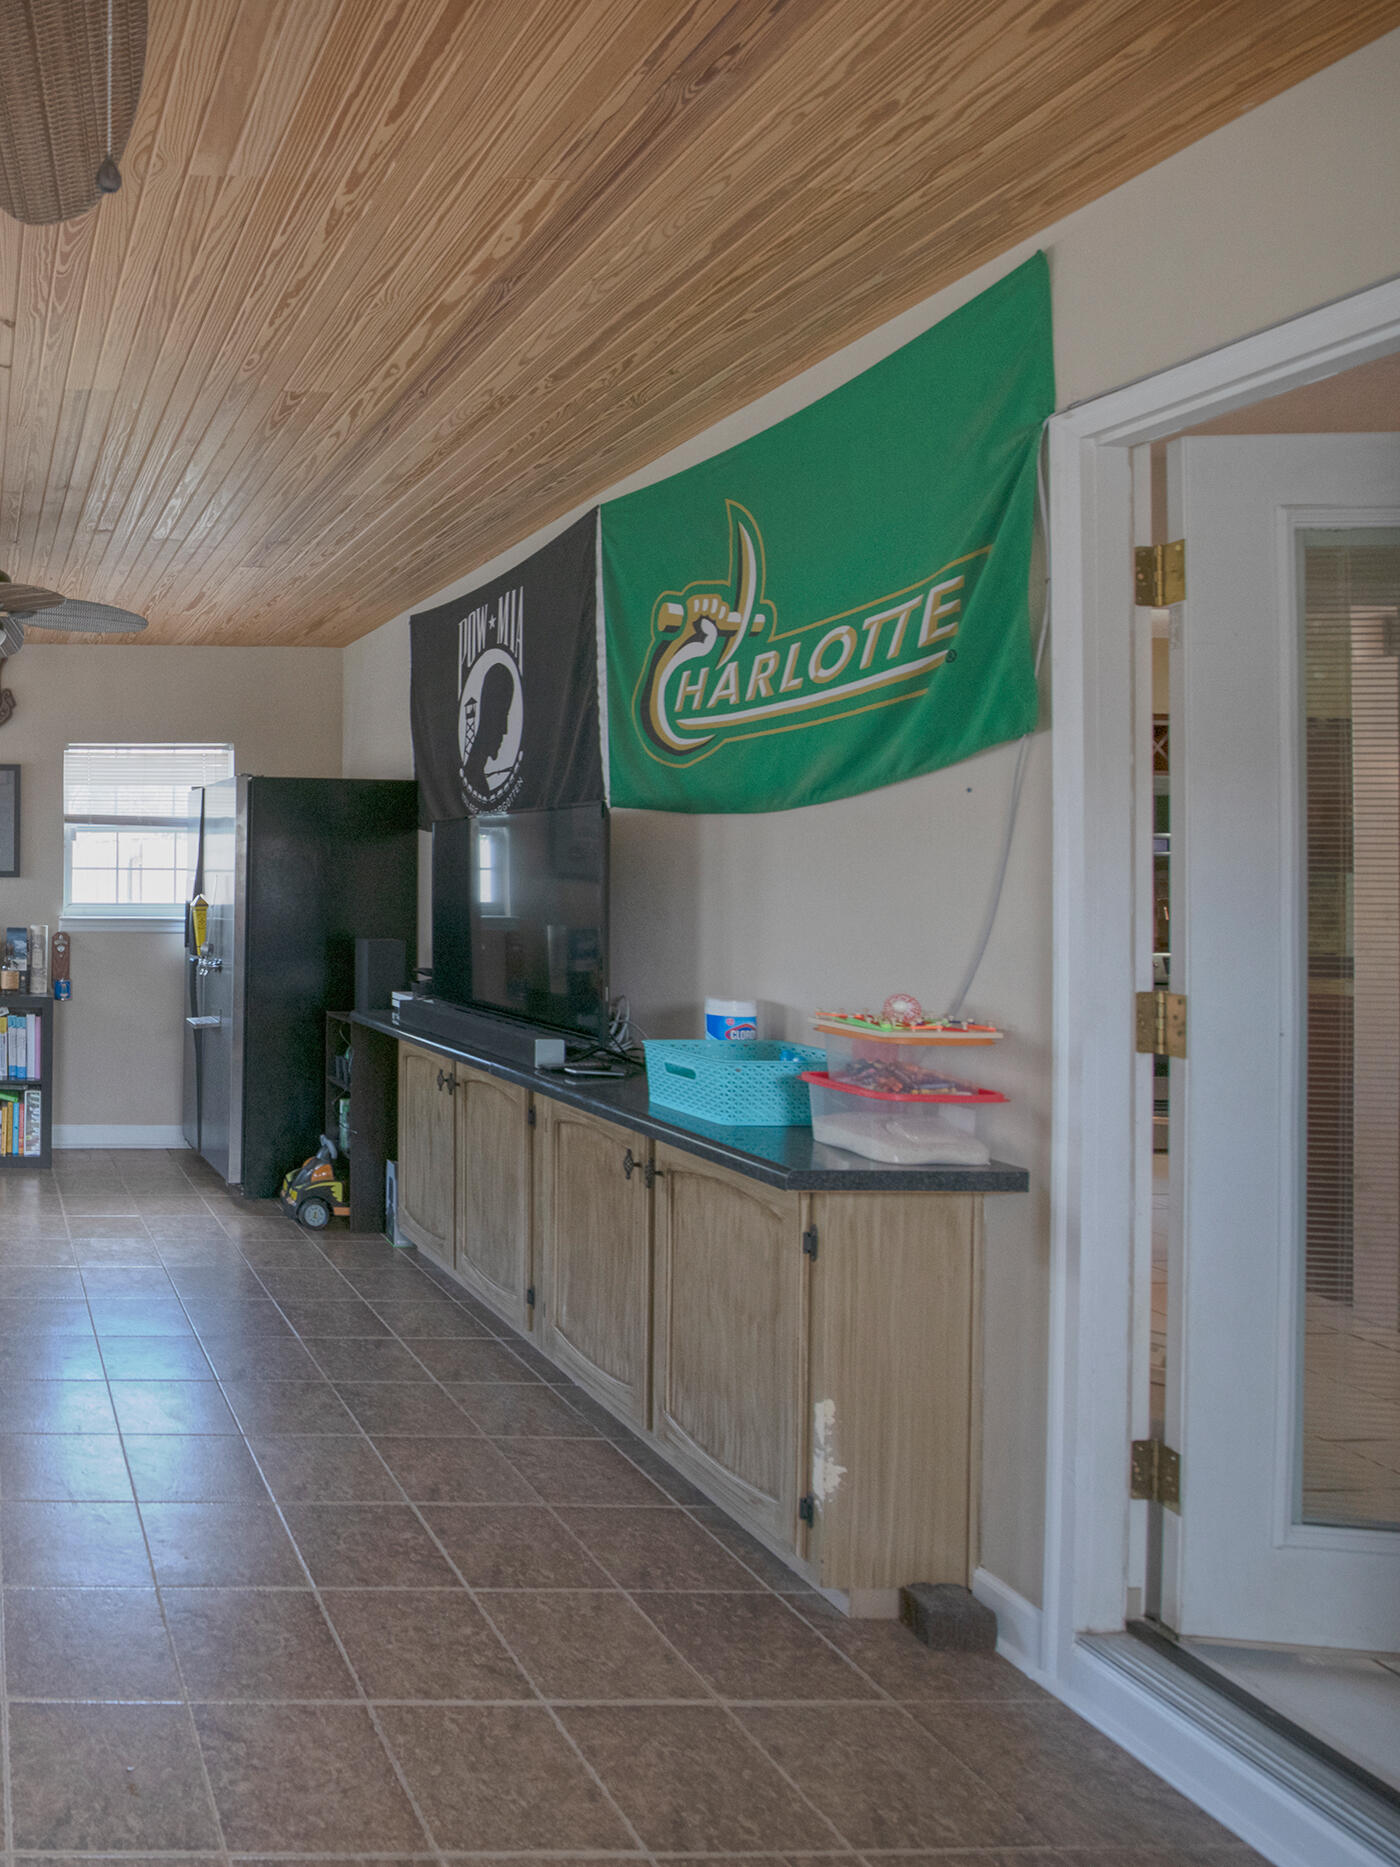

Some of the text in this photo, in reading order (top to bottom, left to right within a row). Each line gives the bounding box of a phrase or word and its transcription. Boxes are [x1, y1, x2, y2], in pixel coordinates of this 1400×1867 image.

[458, 586, 524, 701] POW MIA
[644, 574, 965, 755] CHARLOTTE
